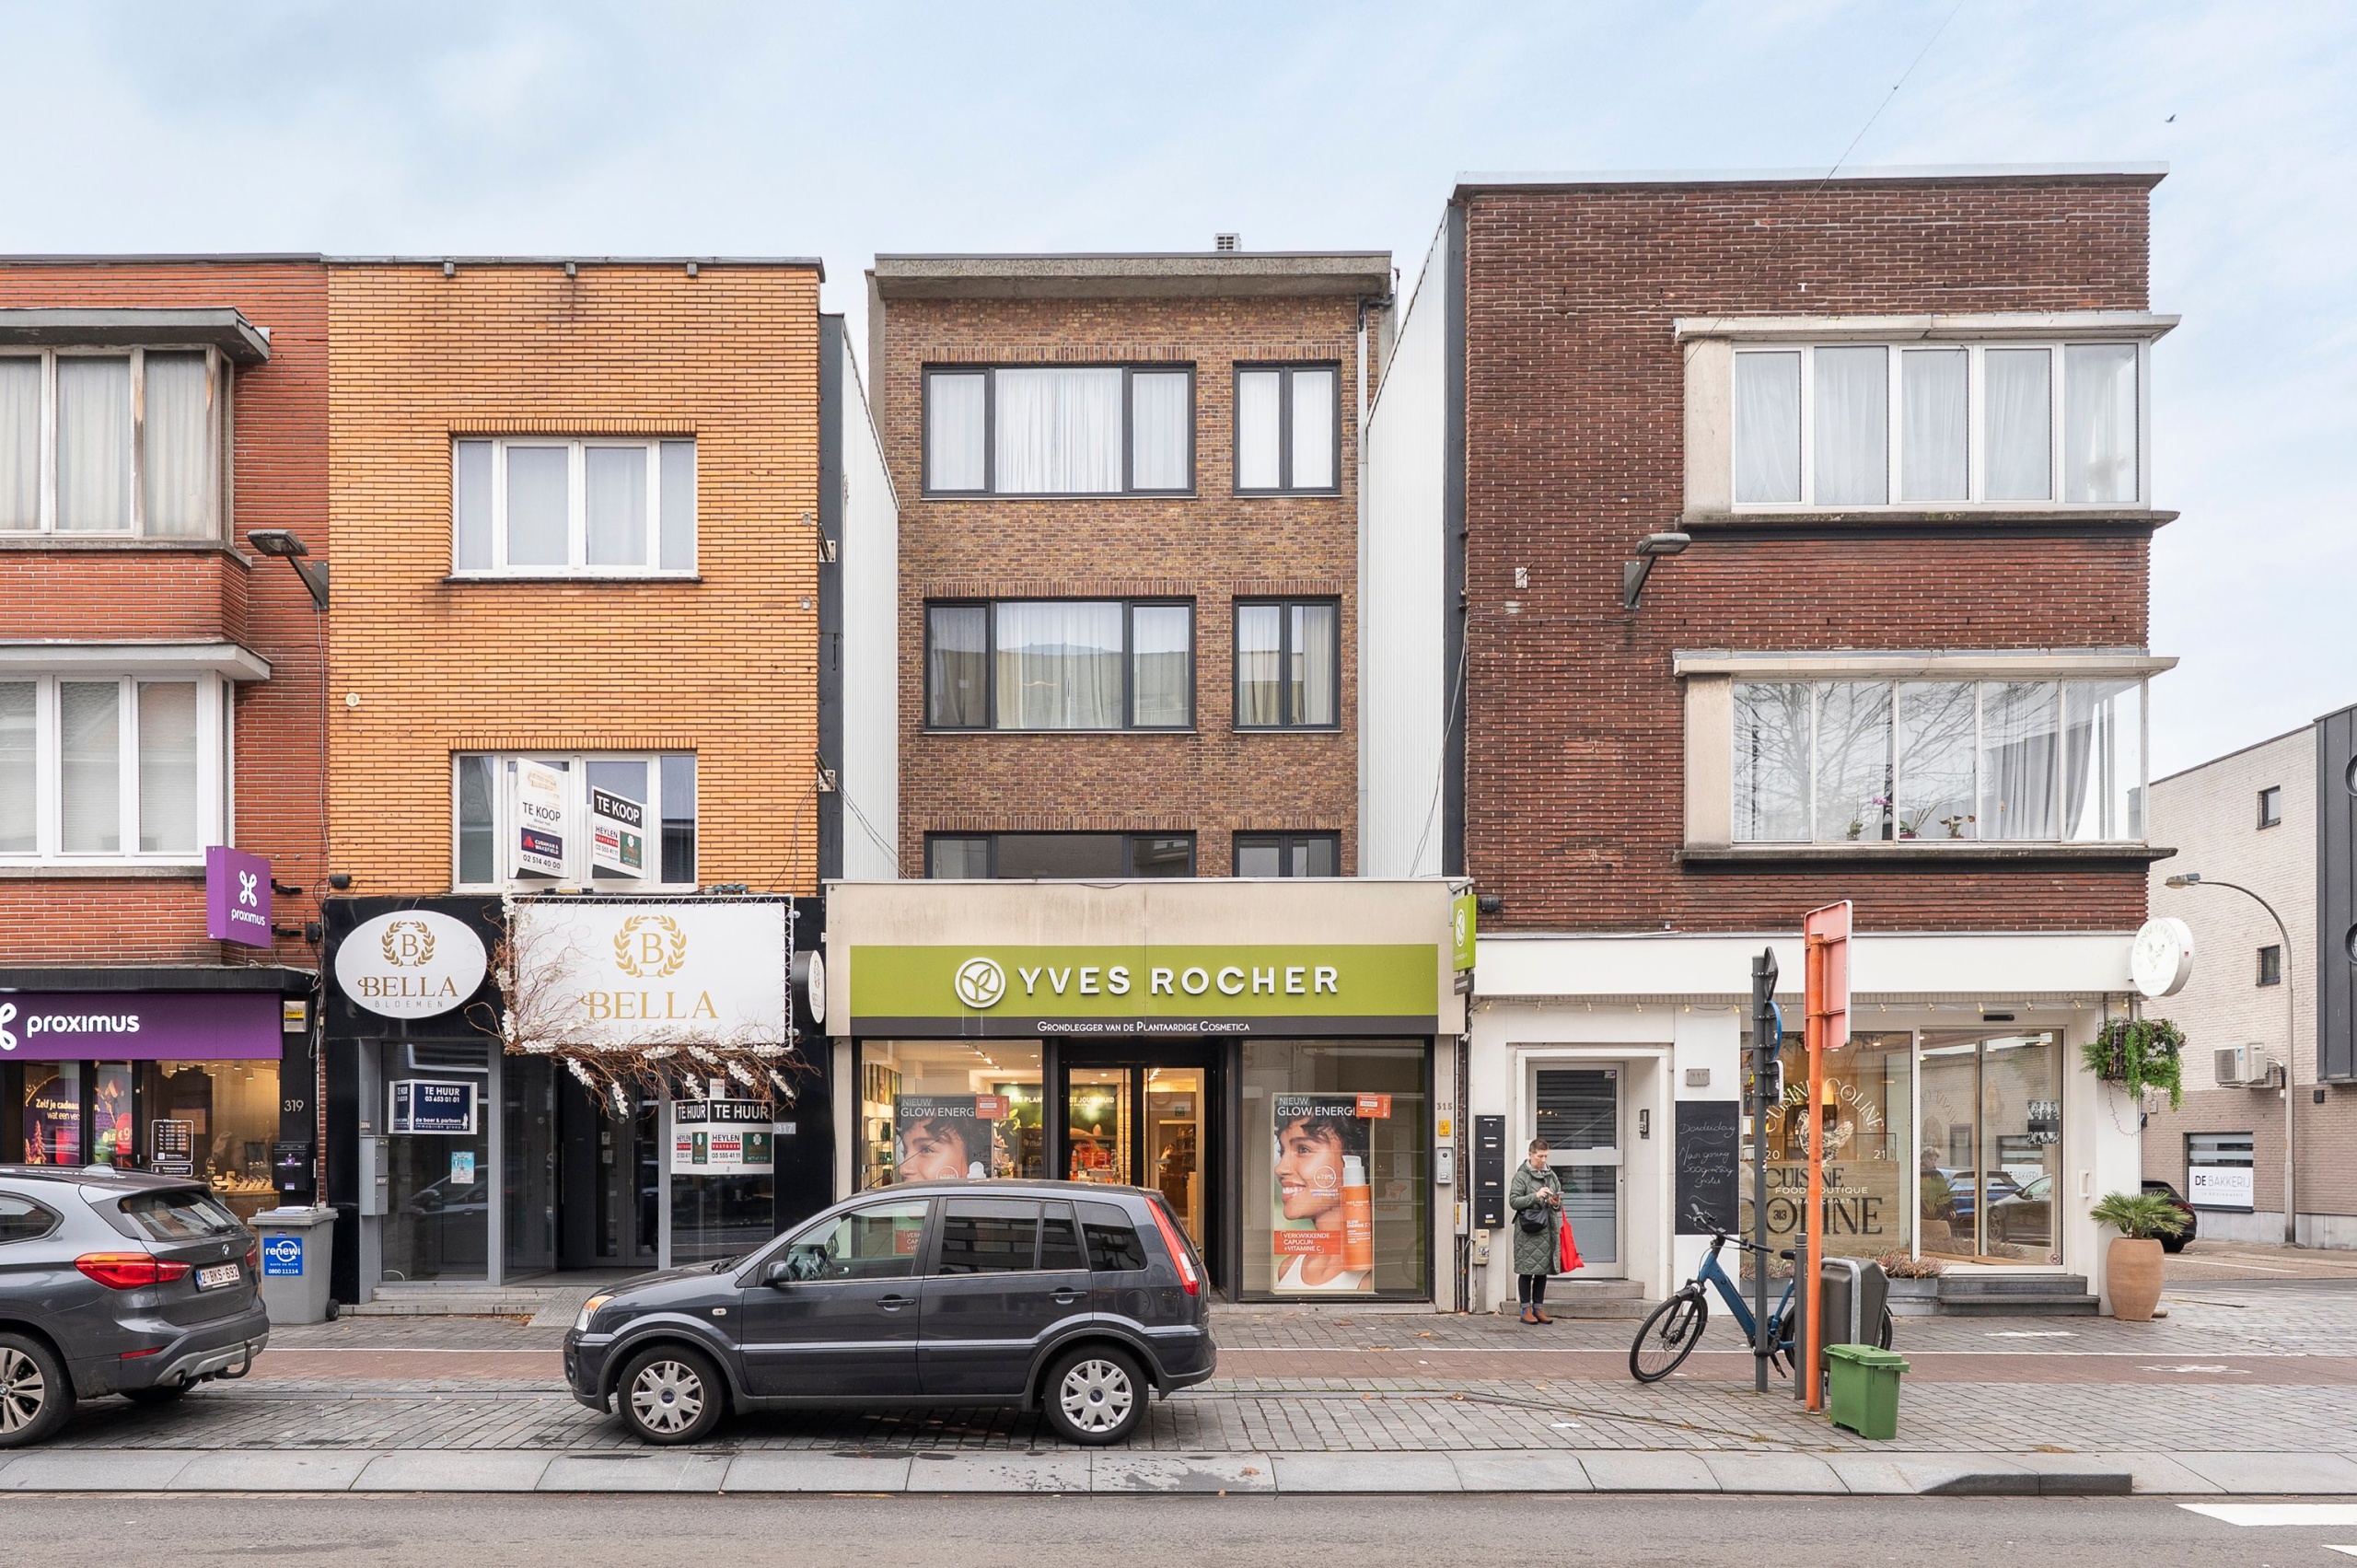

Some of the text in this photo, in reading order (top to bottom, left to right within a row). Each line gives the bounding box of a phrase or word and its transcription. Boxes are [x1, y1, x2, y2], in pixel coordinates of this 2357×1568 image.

[522, 801, 561, 822] TE KOOP
[596, 795, 640, 822] TE KOOP
[595, 825, 618, 839] HEYLEN
[522, 854, 530, 863] 02
[532, 856, 542, 865] 514
[543, 858, 551, 867] 40
[552, 861, 561, 869] 00
[231, 908, 265, 926] proximus
[401, 934, 419, 958] B
[640, 933, 665, 964] B
[357, 976, 459, 997] BELLA
[1017, 966, 1338, 995] YVES ROCHER
[375, 1000, 443, 1008] BLOEMEN
[580, 990, 720, 1019] BELLA
[27, 1015, 140, 1039] proximus
[604, 1024, 697, 1035] BLOEEN
[424, 1086, 460, 1097] TE HUUR
[35, 1098, 49, 1109] Zelf
[49, 1099, 56, 1110] je
[284, 1099, 305, 1112] 319
[902, 1098, 933, 1106] NIEUW
[1436, 1102, 1453, 1110] 315
[1824, 1077, 1885, 1132] COLINE
[47, 1111, 58, 1120] wat
[59, 1112, 70, 1121] een
[678, 1104, 706, 1120] TE HUUR
[714, 1104, 769, 1120] TE HUUR
[900, 1107, 935, 1117] GLOW
[937, 1107, 977, 1117] ENERGI
[1277, 1106, 1313, 1117] GLOW
[1315, 1106, 1355, 1117] ENERGI
[775, 1124, 793, 1132] 317
[712, 1133, 740, 1142] HEYLEN
[1765, 1150, 1886, 1159] 20 21
[1766, 1167, 1844, 1189] CUISNE
[2195, 1175, 2251, 1188] DE BAKKERIJ
[1821, 1186, 1869, 1194] OUTIQUE
[1772, 1209, 1787, 1221] 313
[265, 1245, 301, 1256] renewi
